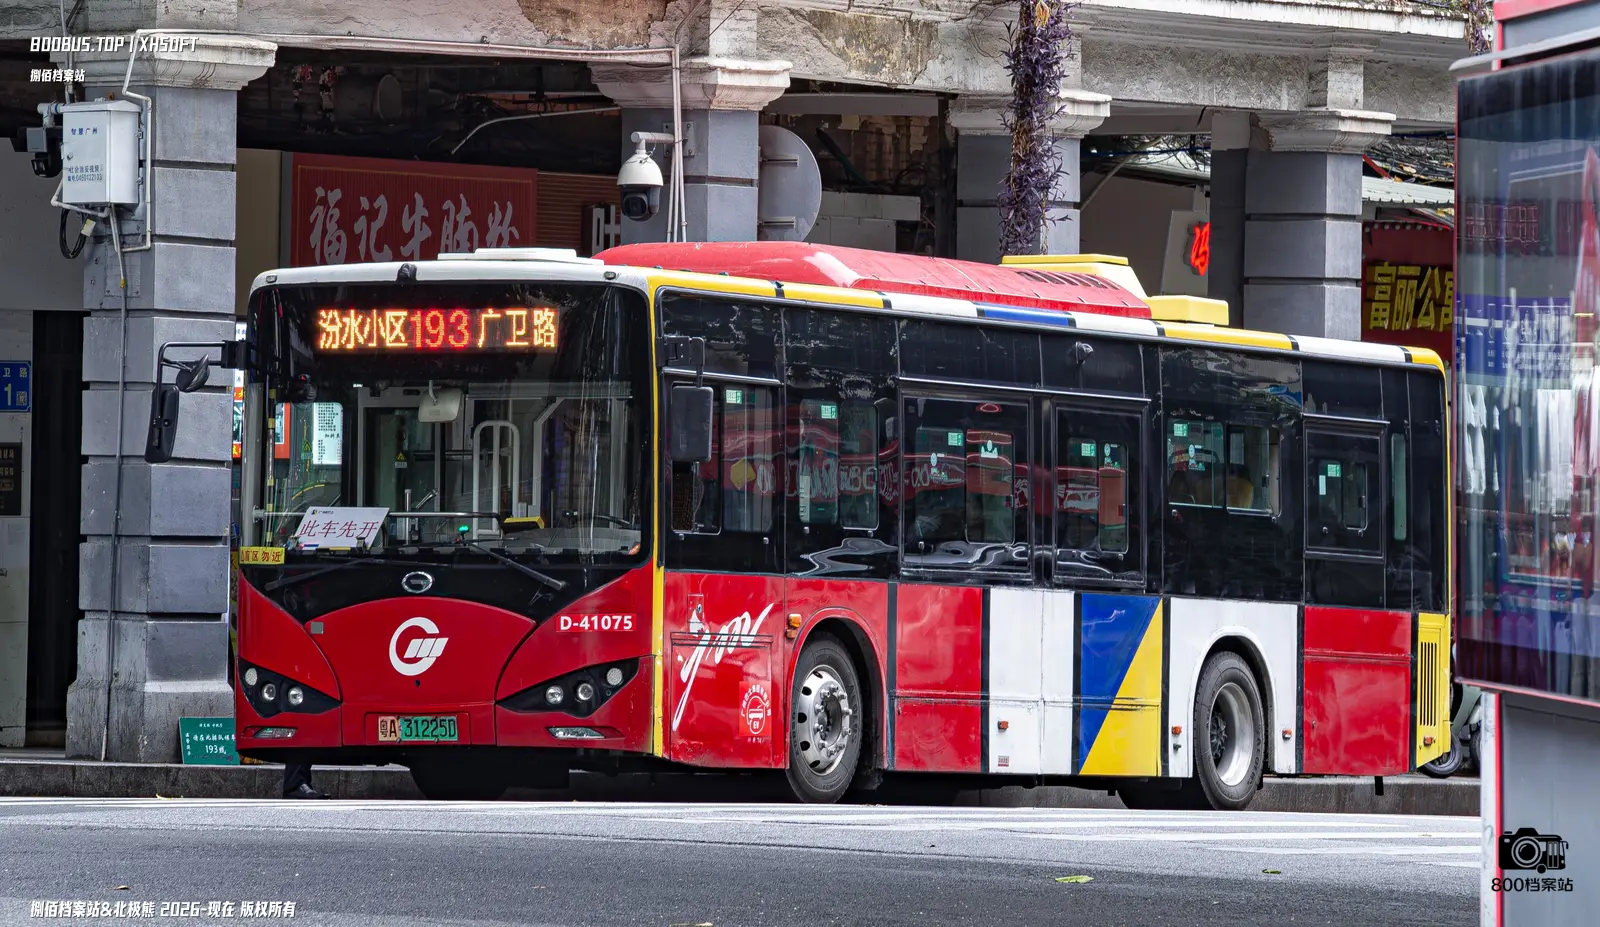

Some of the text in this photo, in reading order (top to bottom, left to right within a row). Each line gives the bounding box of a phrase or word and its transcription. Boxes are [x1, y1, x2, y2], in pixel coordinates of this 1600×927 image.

[318, 308, 556, 349] 汾水小区 193 广卫路
[298, 520, 380, 538] 此车先开
[560, 616, 633, 631] D-41075
